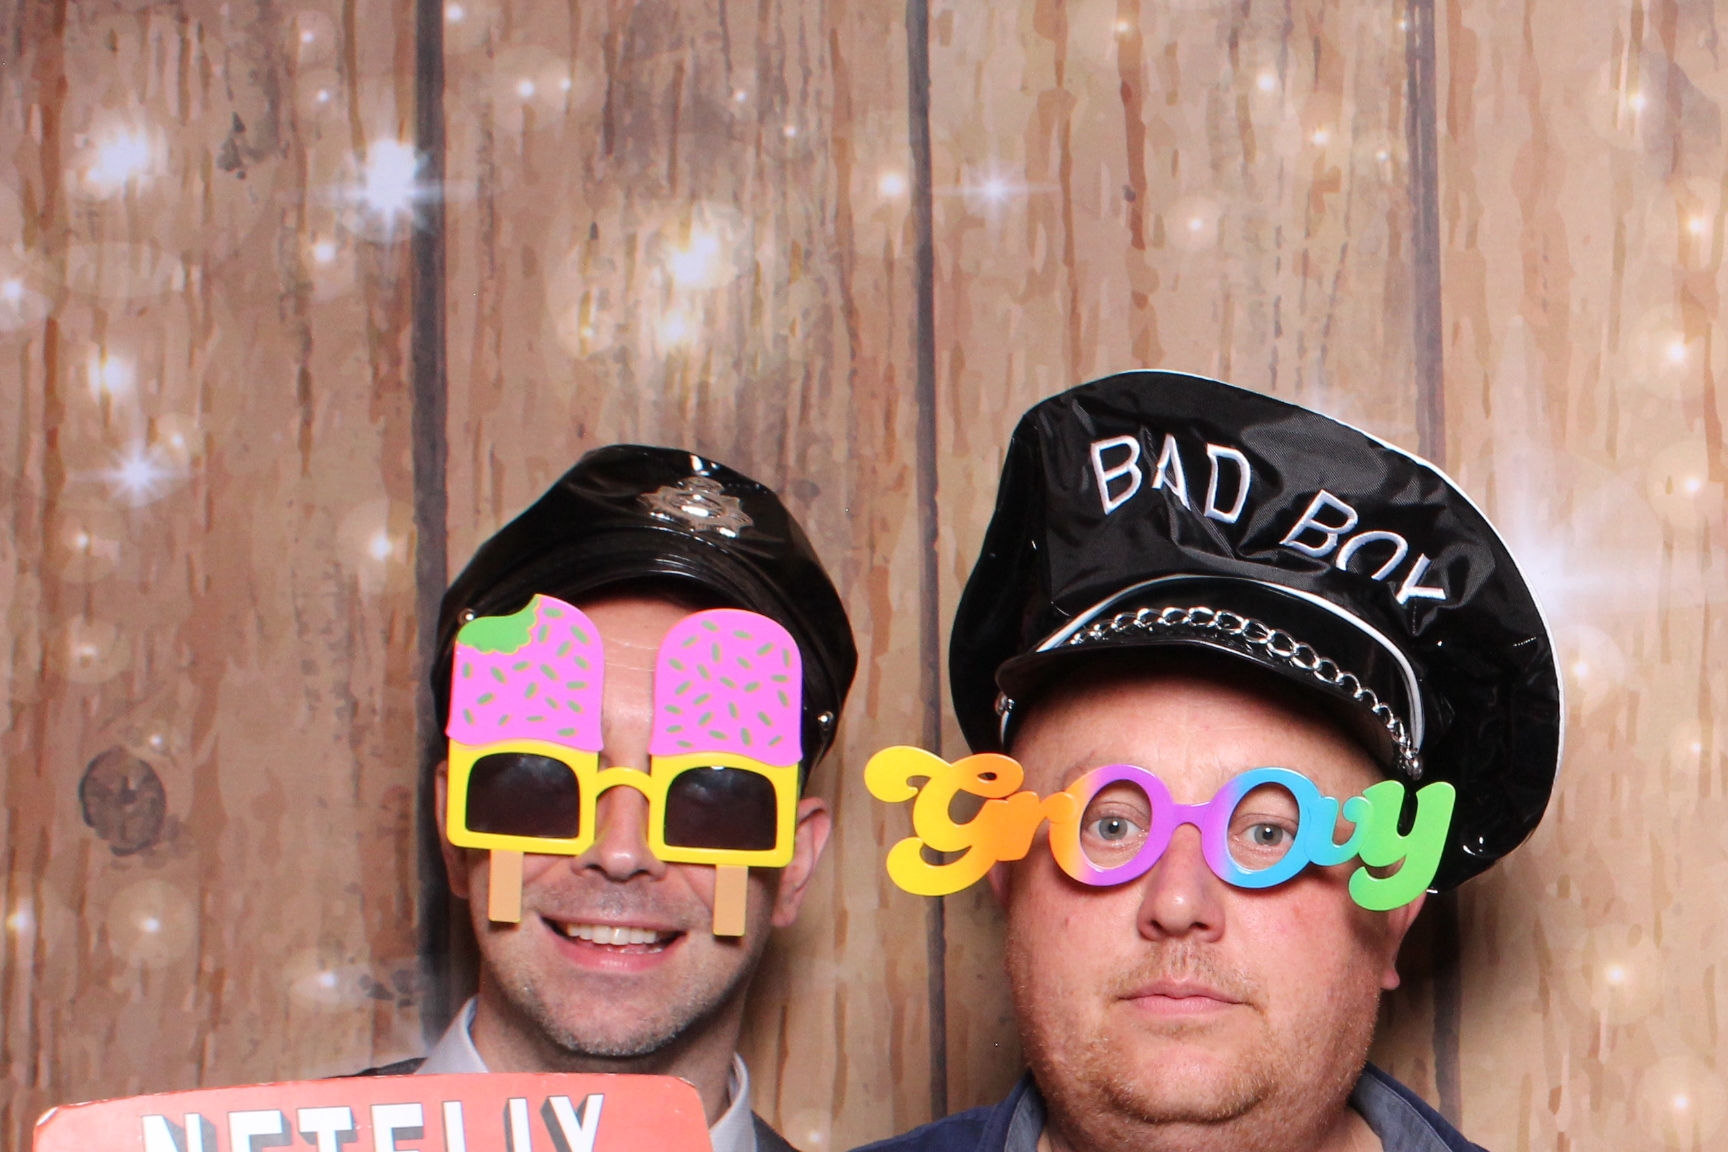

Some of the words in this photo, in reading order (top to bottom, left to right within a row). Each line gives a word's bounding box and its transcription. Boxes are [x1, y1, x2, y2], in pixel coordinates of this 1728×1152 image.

[1089, 434, 1251, 524] BAD
[1278, 488, 1447, 606] BOY
[864, 745, 1457, 911] Groovy
